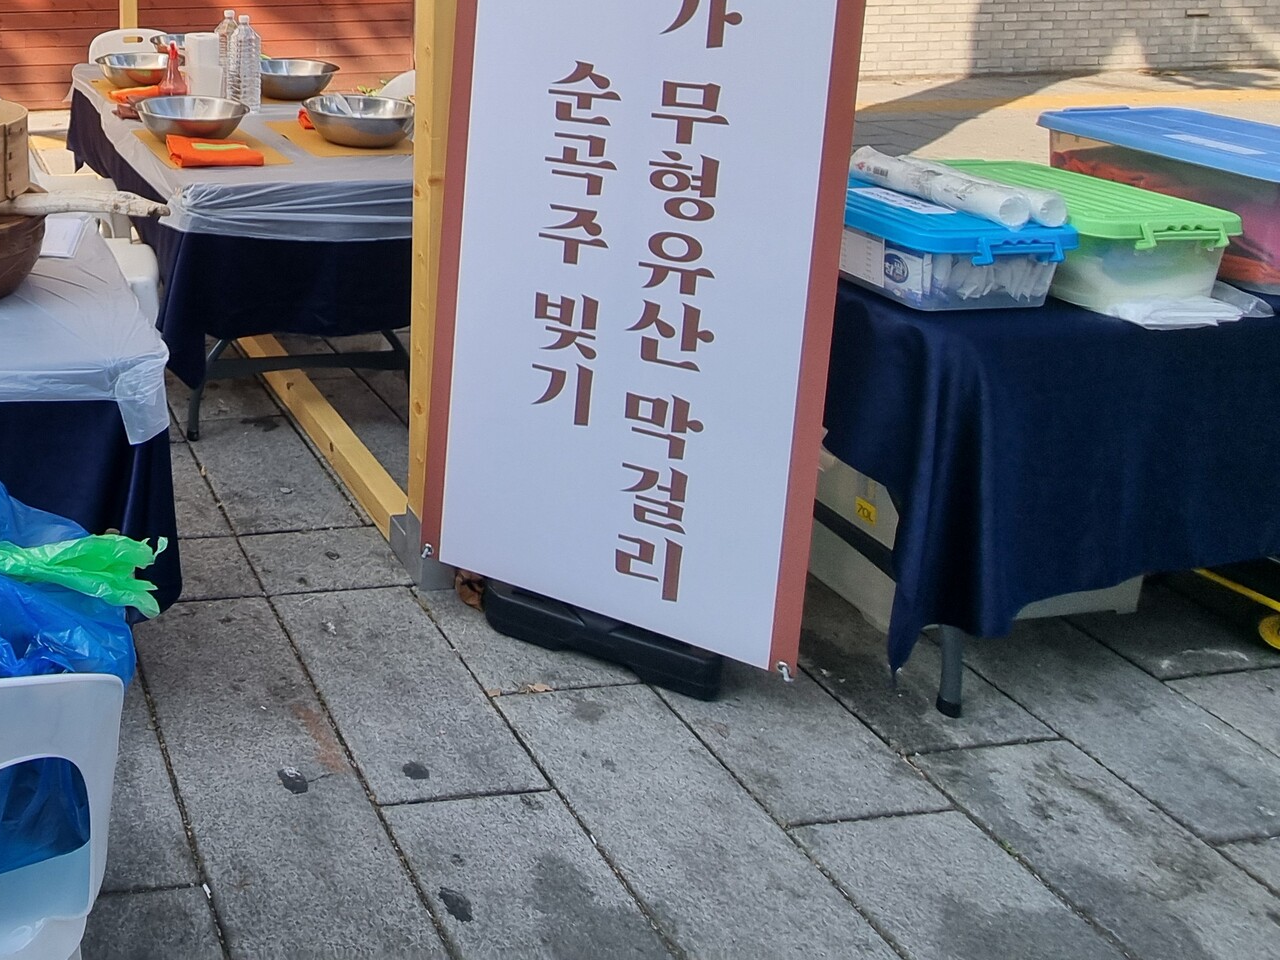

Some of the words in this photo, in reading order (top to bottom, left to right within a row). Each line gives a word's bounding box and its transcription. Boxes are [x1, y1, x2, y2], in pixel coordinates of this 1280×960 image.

[538, 60, 622, 265] 순곡주
[625, 80, 730, 372] 무형유산
[530, 291, 600, 427] 빚기
[614, 391, 704, 602] 막걸리
